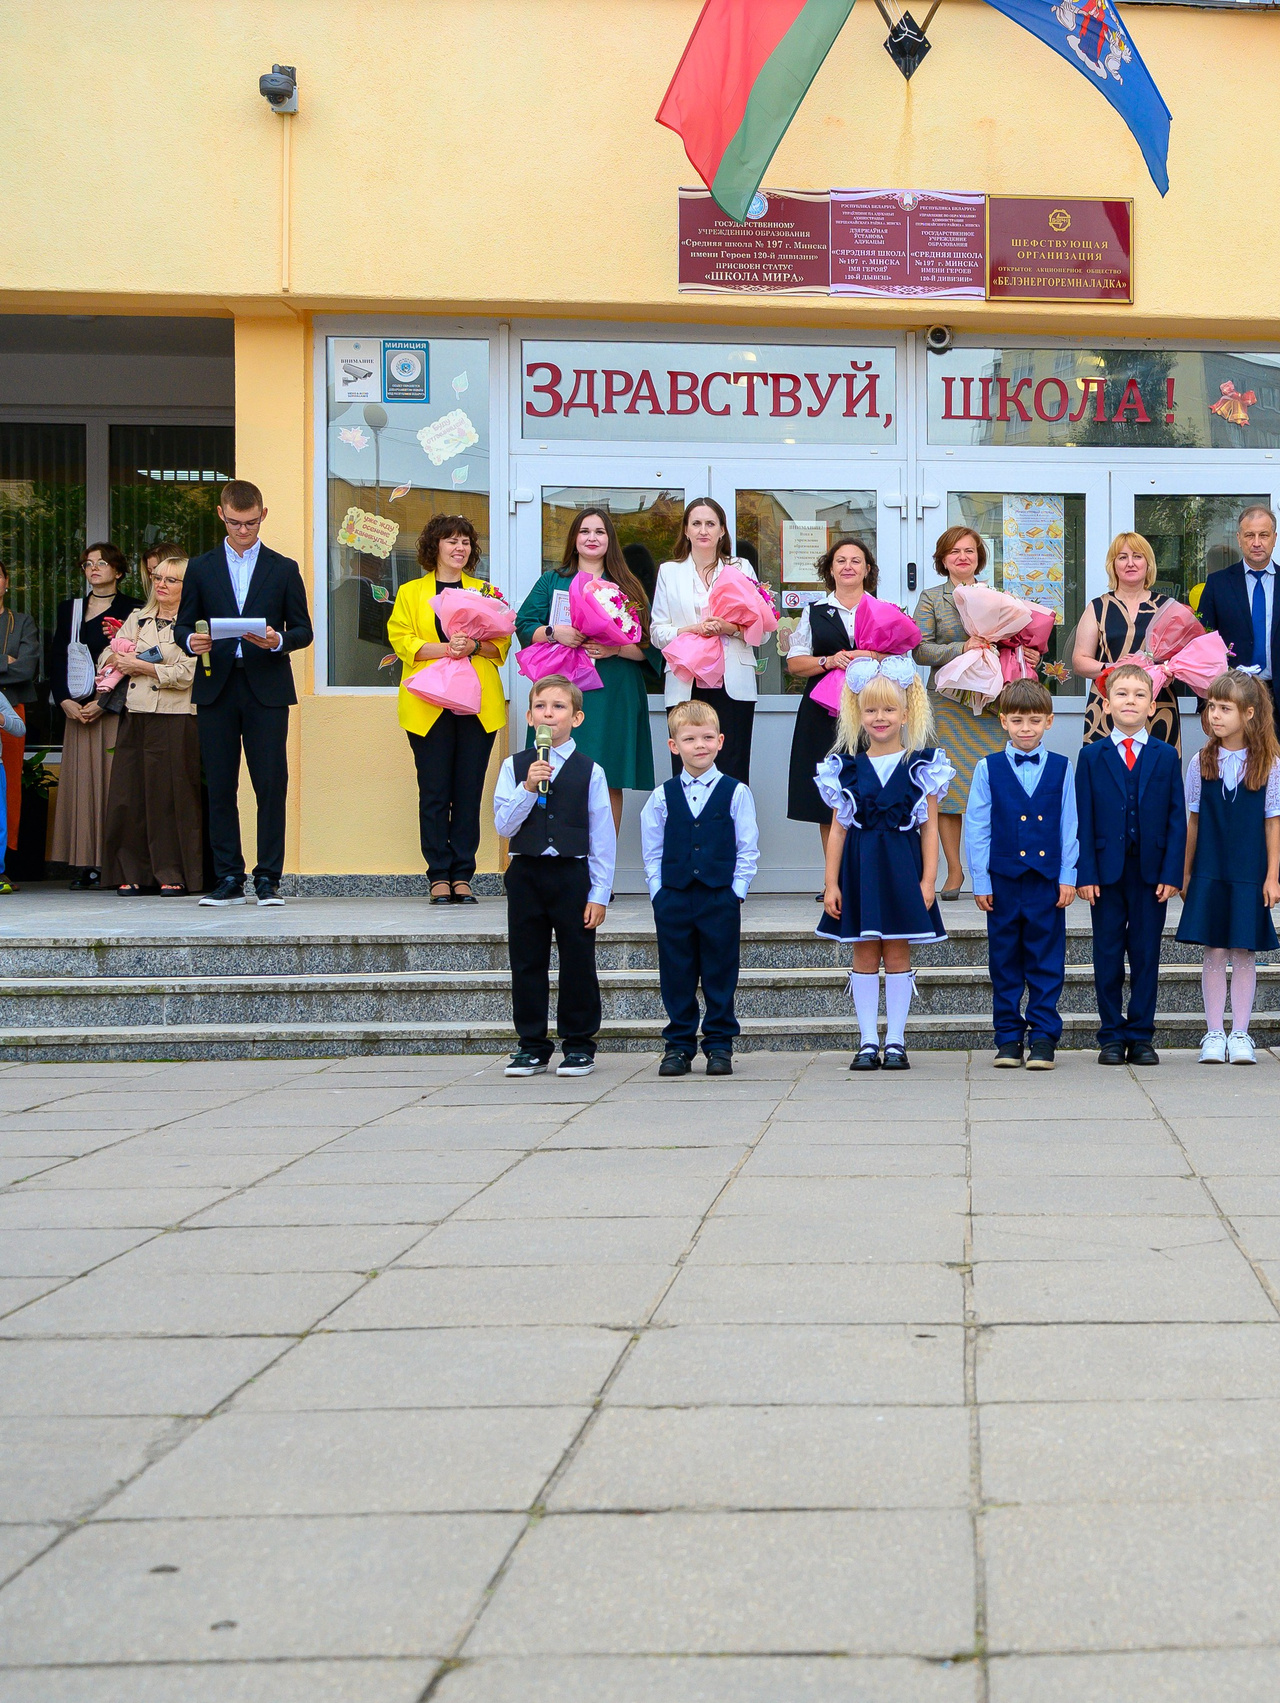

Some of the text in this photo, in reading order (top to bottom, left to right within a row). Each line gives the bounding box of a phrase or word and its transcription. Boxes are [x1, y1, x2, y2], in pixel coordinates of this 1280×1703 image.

[698, 228, 811, 238] УЧРЕЖДЕНИЮ ОБРАЗОВАНИЯ
[755, 240, 764, 248] №
[767, 240, 783, 249] 197
[794, 241, 827, 250] Минска
[1011, 239, 1108, 249] ШЕФСТВУЮЩАЯ
[1017, 251, 1102, 261] ОРГАНИЗАЦИЯ
[716, 262, 760, 270] ПРИСВОЕН
[704, 272, 804, 282] «ШКОЛА МИРА»
[993, 276, 1127, 289] «БЕЛЭНЕРГОРЕМНАЛАДКА»
[525, 360, 893, 429] ЗДРАВСТВУЙ,
